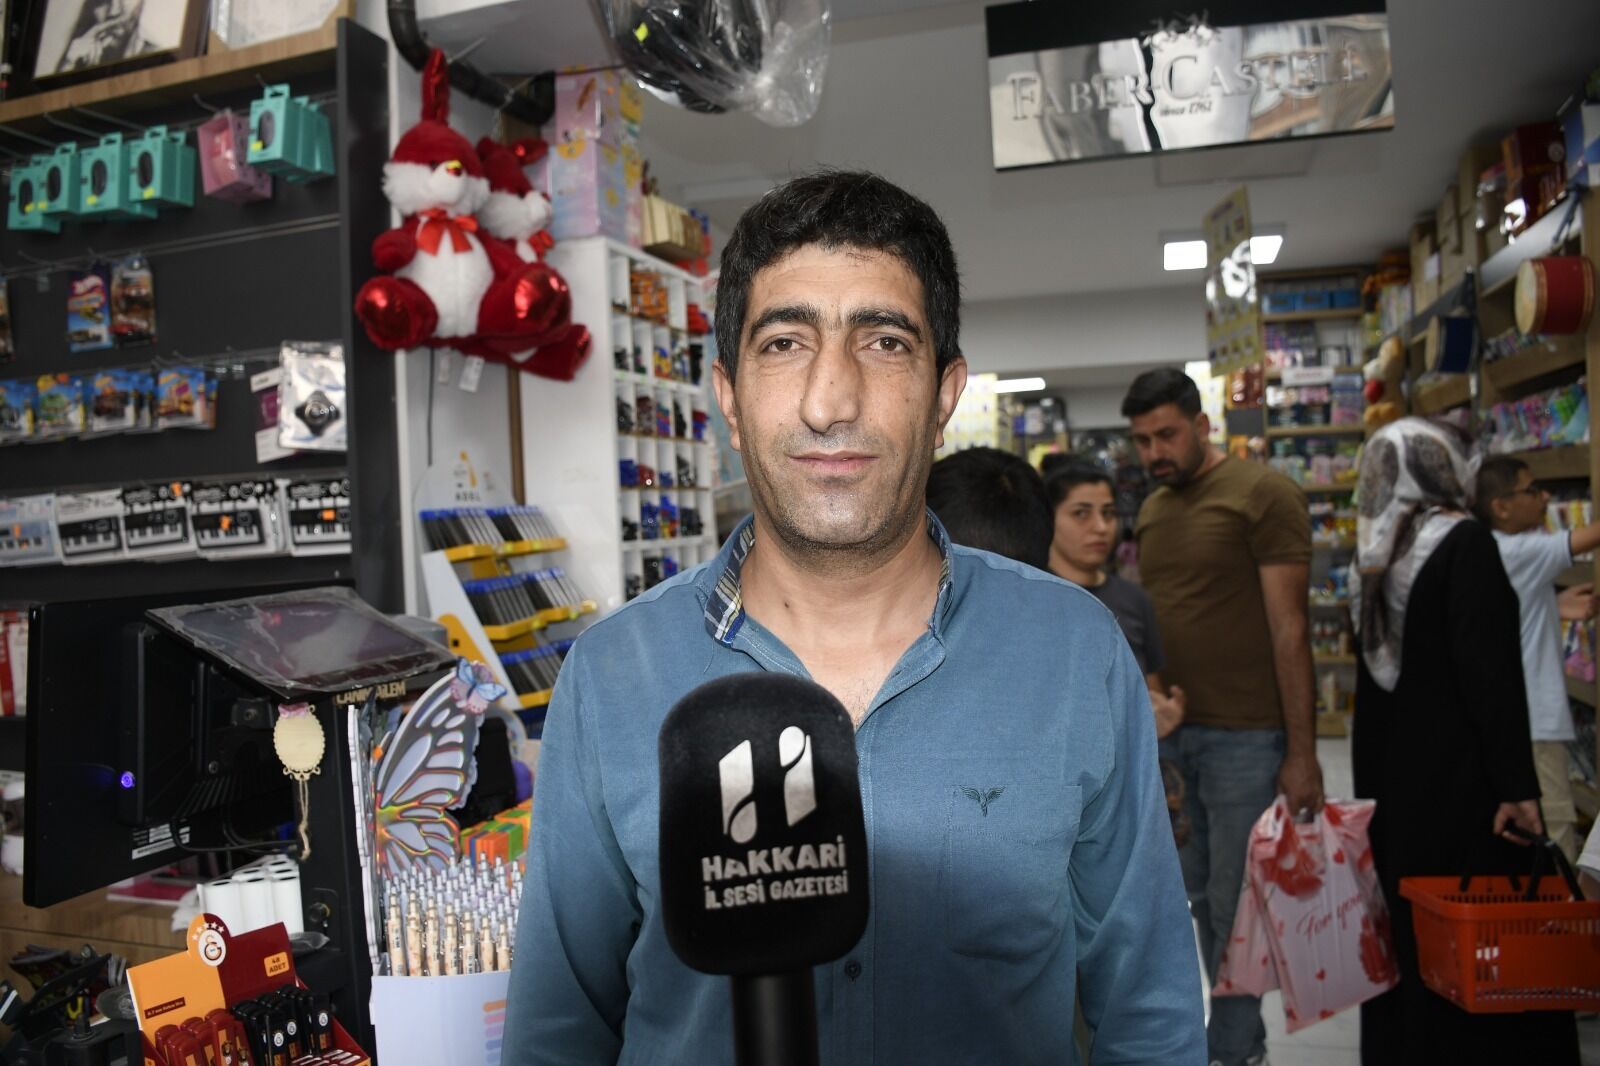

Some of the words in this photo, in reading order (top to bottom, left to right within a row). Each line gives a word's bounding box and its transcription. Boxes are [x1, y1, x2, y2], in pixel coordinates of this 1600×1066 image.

[701, 835, 845, 882] HAKKARİ
[704, 885, 722, 909] İL
[723, 878, 766, 907] SESİ
[769, 869, 848, 900] GAZETESİ
